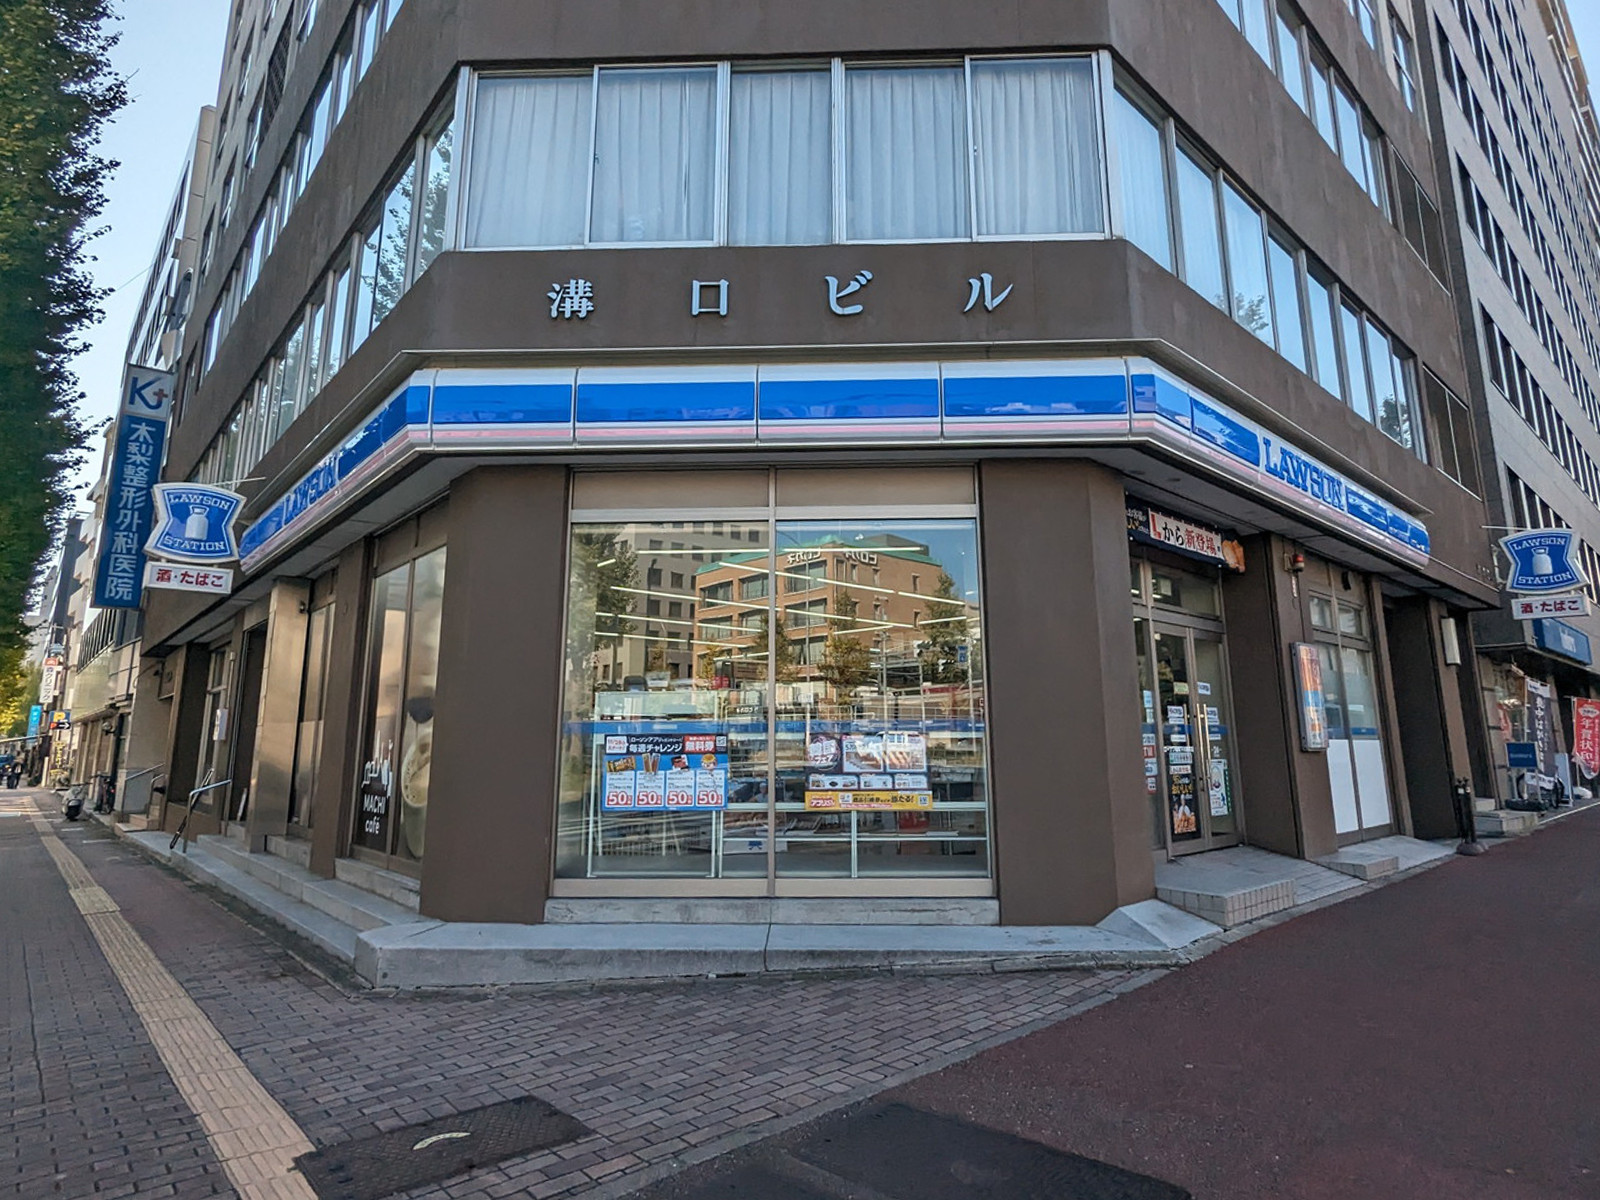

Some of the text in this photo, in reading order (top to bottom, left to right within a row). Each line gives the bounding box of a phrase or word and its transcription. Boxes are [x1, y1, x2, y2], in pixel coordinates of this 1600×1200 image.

[547, 269, 1014, 319] 溝口ビル
[1263, 437, 1345, 511] LAWSON
[169, 492, 231, 511] LAWSON
[105, 422, 156, 602] 木梨整形外科医院
[163, 535, 226, 553] STATION
[1512, 536, 1566, 551] LAWSON
[156, 568, 224, 588] 酒・たばこ
[1518, 571, 1572, 585] STATION
[1520, 599, 1580, 614] 酒・たばこ
[53, 711, 66, 723] P
[363, 794, 387, 815] MACHI
[364, 816, 380, 835] café
